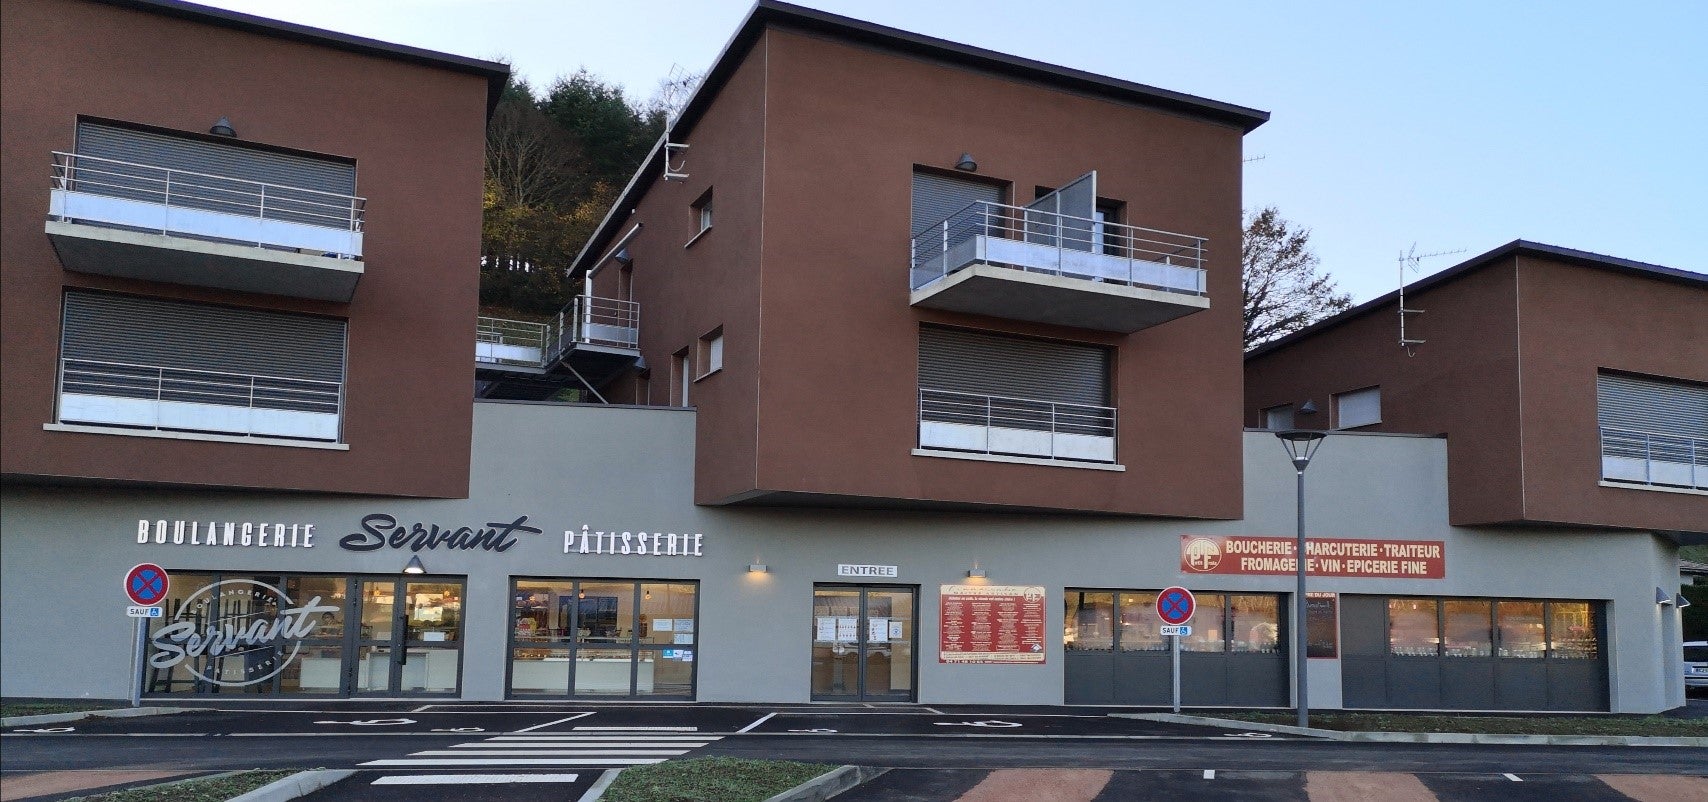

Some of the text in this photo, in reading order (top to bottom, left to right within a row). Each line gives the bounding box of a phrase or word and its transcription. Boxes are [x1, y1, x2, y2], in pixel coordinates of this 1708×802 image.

[137, 519, 315, 548] BOULANGERIE
[339, 513, 543, 552] Servant
[563, 524, 703, 556] PÂTISSERIE
[1226, 540, 1440, 558] BOUCHERIE HARCUTERIE TRAITEUR
[841, 565, 895, 576] ENTREE
[1320, 559, 1341, 572] VIN
[1347, 560, 1398, 574] EPICERIE
[1401, 561, 1427, 575] FINE
[150, 595, 340, 669] Servant
